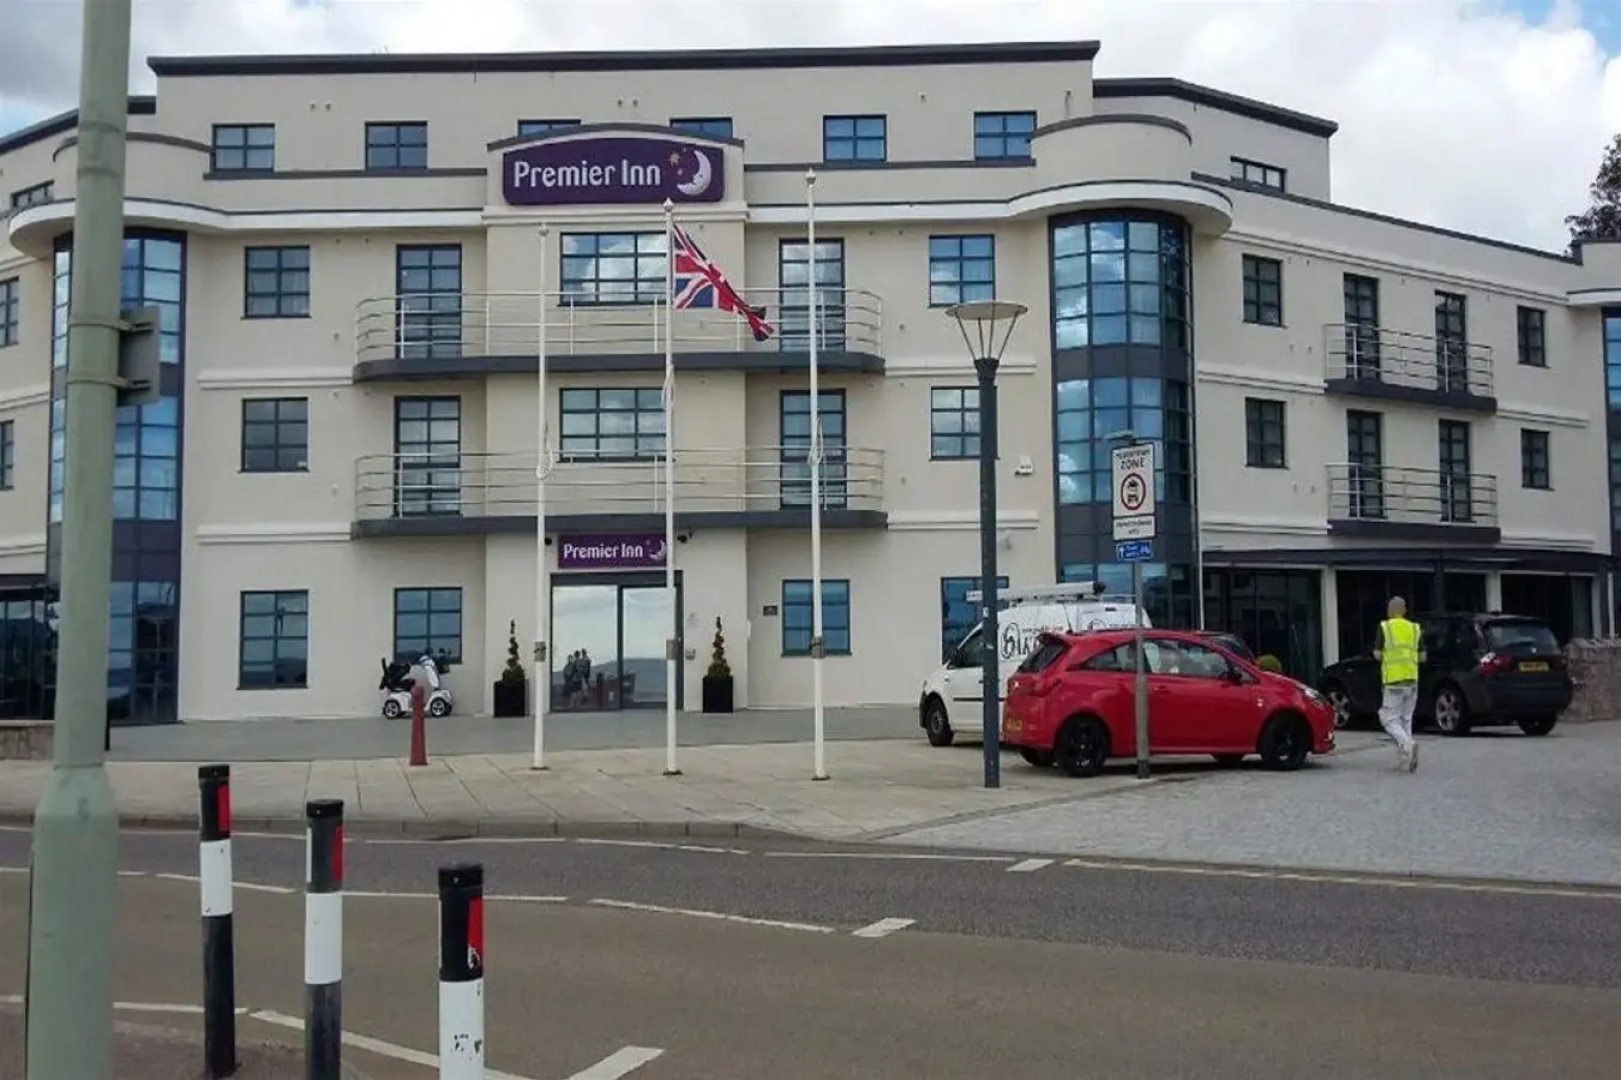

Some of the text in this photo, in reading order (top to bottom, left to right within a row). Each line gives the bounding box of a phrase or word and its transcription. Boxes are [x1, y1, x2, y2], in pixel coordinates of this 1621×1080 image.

[513, 159, 661, 187] Premier Inn
[1121, 457, 1145, 470] ZONE
[563, 543, 643, 559] Premier Inn
